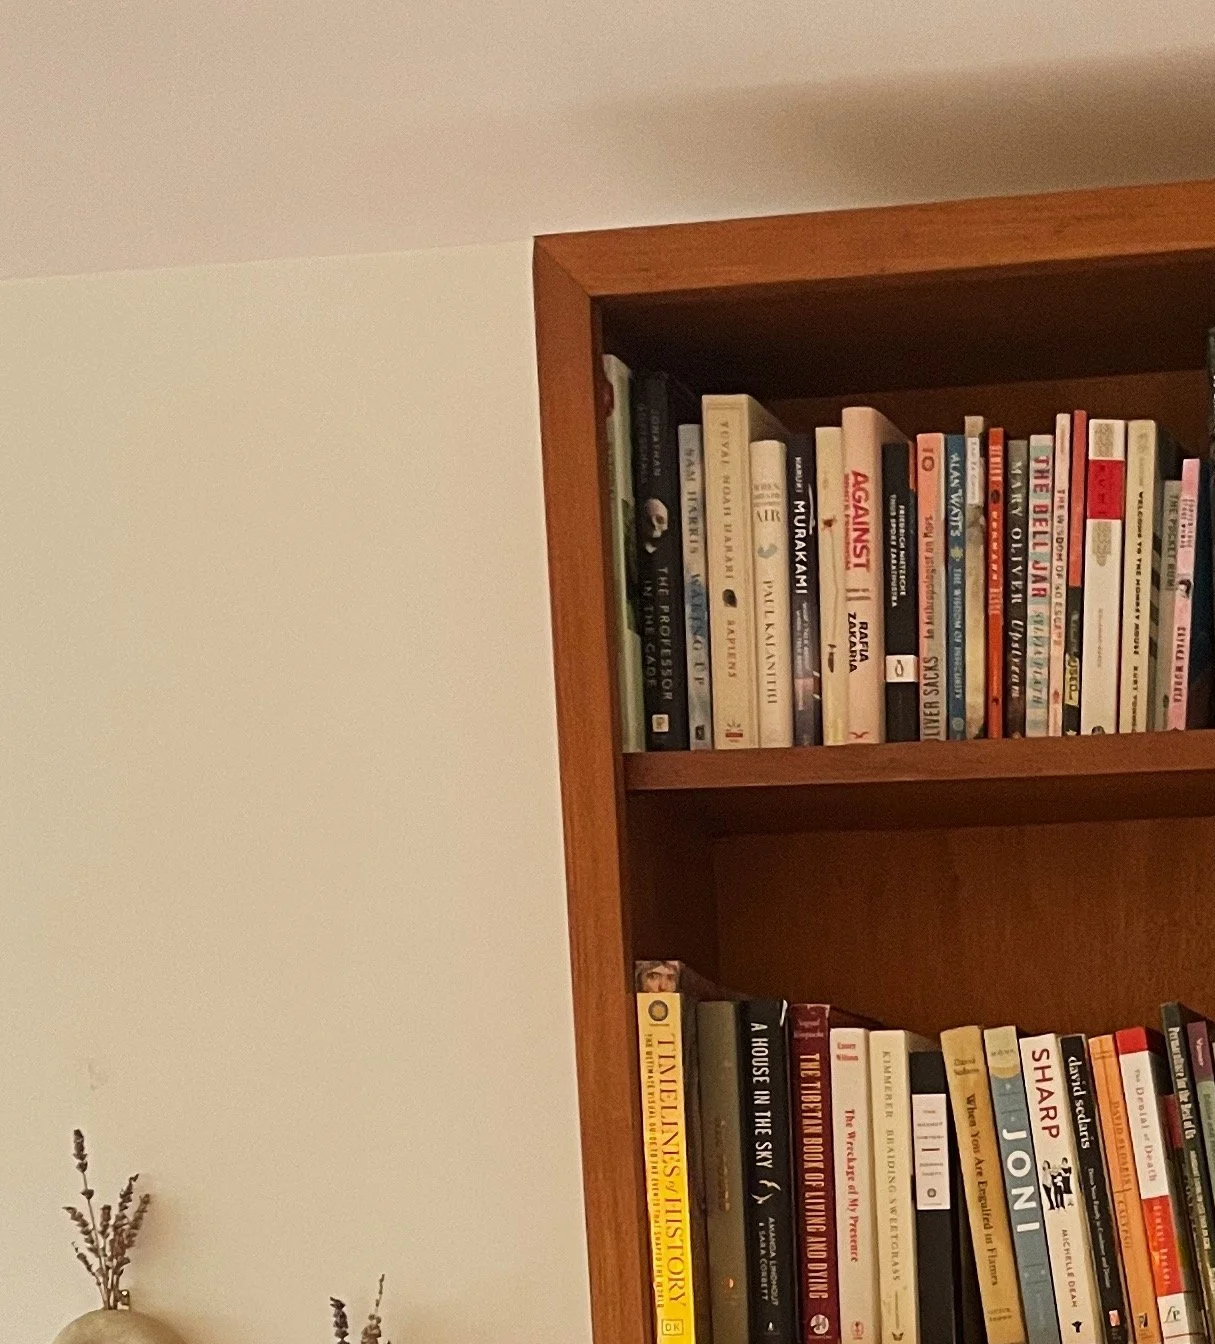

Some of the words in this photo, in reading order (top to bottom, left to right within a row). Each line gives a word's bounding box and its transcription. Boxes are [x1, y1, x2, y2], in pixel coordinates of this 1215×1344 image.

[720, 421, 729, 465] YUVAL
[722, 475, 732, 515] NOAH
[1011, 461, 1022, 516] MARY
[1034, 456, 1048, 494] THE
[852, 470, 870, 573] AGAINST
[1033, 503, 1049, 551] BELL
[724, 524, 734, 579] HARARI
[1011, 528, 1023, 604] OLIVER
[658, 568, 669, 594] THE
[762, 581, 775, 618] PAUL
[1033, 560, 1048, 598] JAR
[660, 605, 673, 700] PROFESSOR
[727, 619, 737, 678] SAPIENS
[764, 622, 778, 704] KALANITHI
[848, 612, 858, 672] ZAKARIA
[859, 621, 868, 663] RAFIA
[1010, 619, 1024, 698] Upstream
[750, 1022, 768, 1031] A
[751, 1037, 770, 1084] HOUSE
[800, 1053, 819, 1078] THE
[1067, 1056, 1085, 1096] david
[753, 1090, 770, 1105] IN
[882, 1051, 894, 1118] KIMMERER
[657, 1033, 680, 1179] TIMELINES
[753, 1111, 772, 1136] THE
[801, 1082, 821, 1133] TIBETAN
[845, 1109, 856, 1127] The
[964, 1092, 978, 1129] When
[1074, 1100, 1094, 1149] sedaris
[755, 1142, 773, 1168] SKY
[803, 1137, 823, 1170] BOOK
[844, 1130, 857, 1183] Wreckage
[885, 1128, 896, 1193] BRAIDING
[970, 1132, 981, 1154] You
[804, 1172, 823, 1188] OF
[973, 1156, 986, 1177] Are
[1002, 1128, 1039, 1232] JONI
[1032, 1048, 1060, 1139] SHARP
[1061, 1228, 1074, 1277] MICHELLE
[1068, 1280, 1078, 1308] DEAN
[846, 1199, 859, 1213] My
[848, 1185, 858, 1195] of
[977, 1179, 994, 1230] Engulfed
[804, 1191, 825, 1232] LIVING
[663, 1198, 687, 1309] HISTORY
[806, 1236, 827, 1259] AND
[849, 1215, 860, 1262] Presence
[889, 1199, 901, 1281] SWEETGRASS
[984, 1232, 994, 1244] in
[807, 1263, 829, 1299] DYING
[986, 1248, 1000, 1286] Flames
